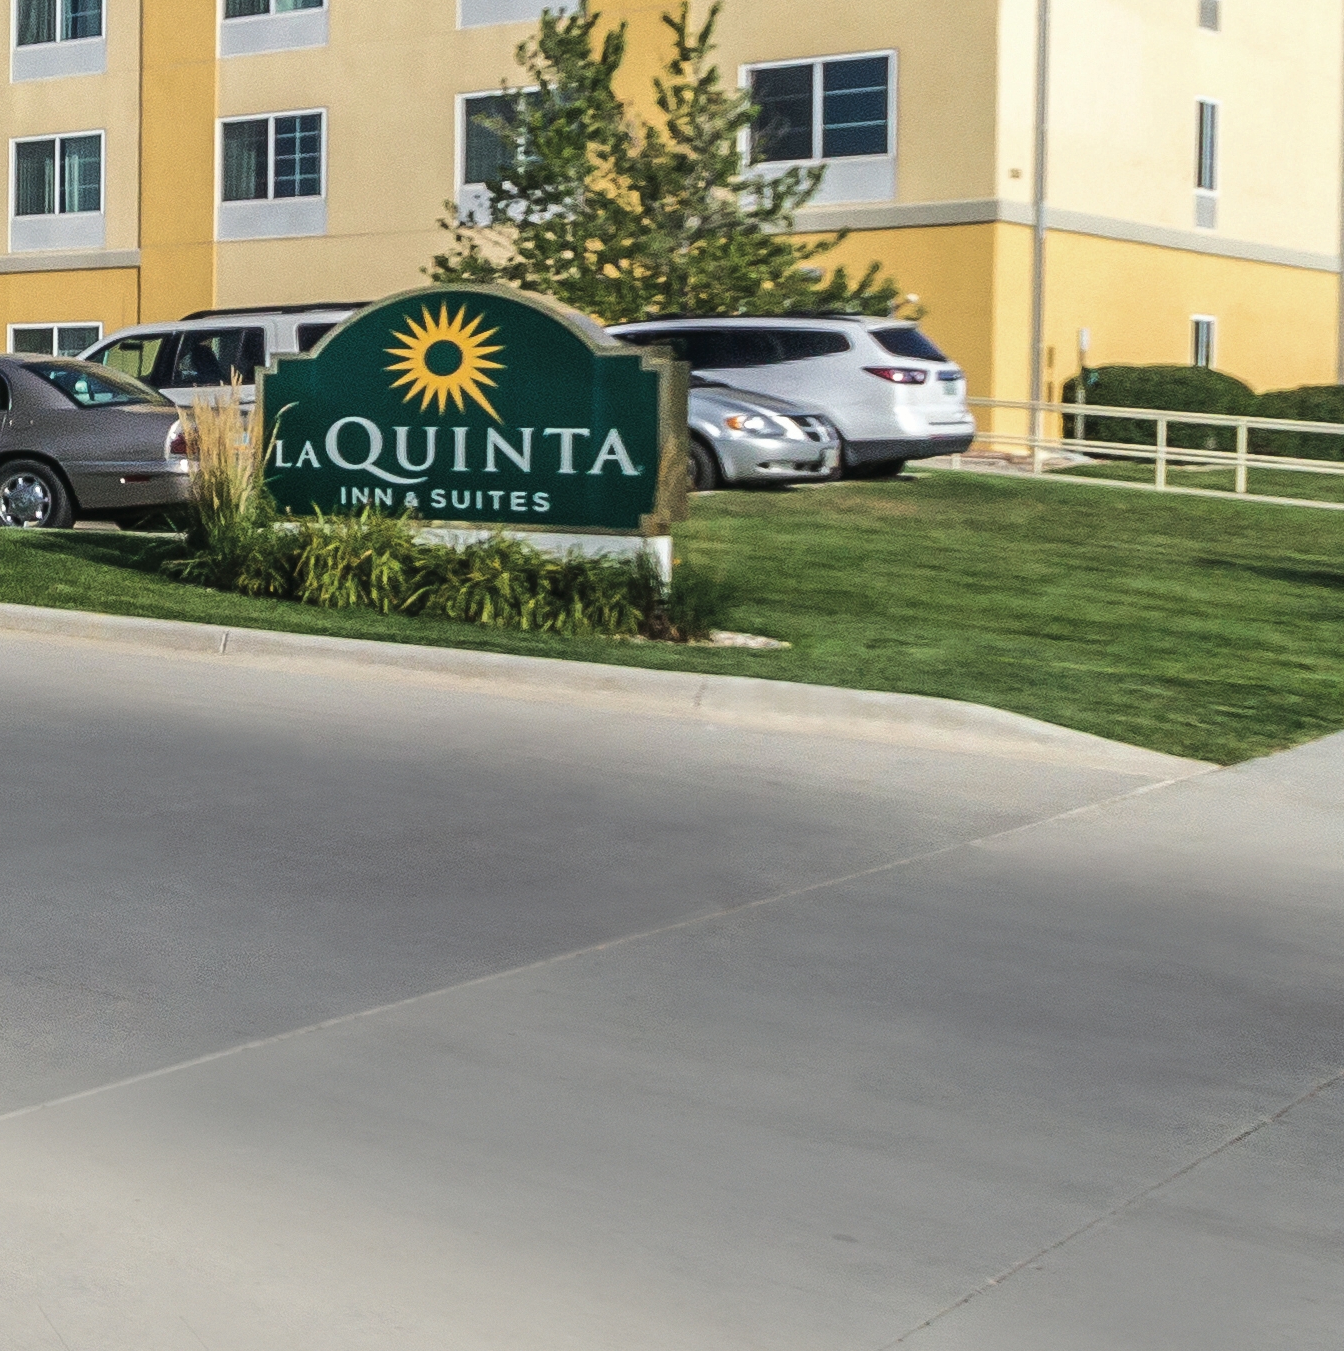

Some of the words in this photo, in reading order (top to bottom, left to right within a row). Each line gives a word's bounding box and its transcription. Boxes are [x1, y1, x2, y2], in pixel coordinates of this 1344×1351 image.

[275, 439, 322, 468] LA
[325, 416, 641, 484] QUINTA
[340, 486, 393, 506] INN
[404, 491, 420, 507] &
[430, 488, 550, 512] SUITES
